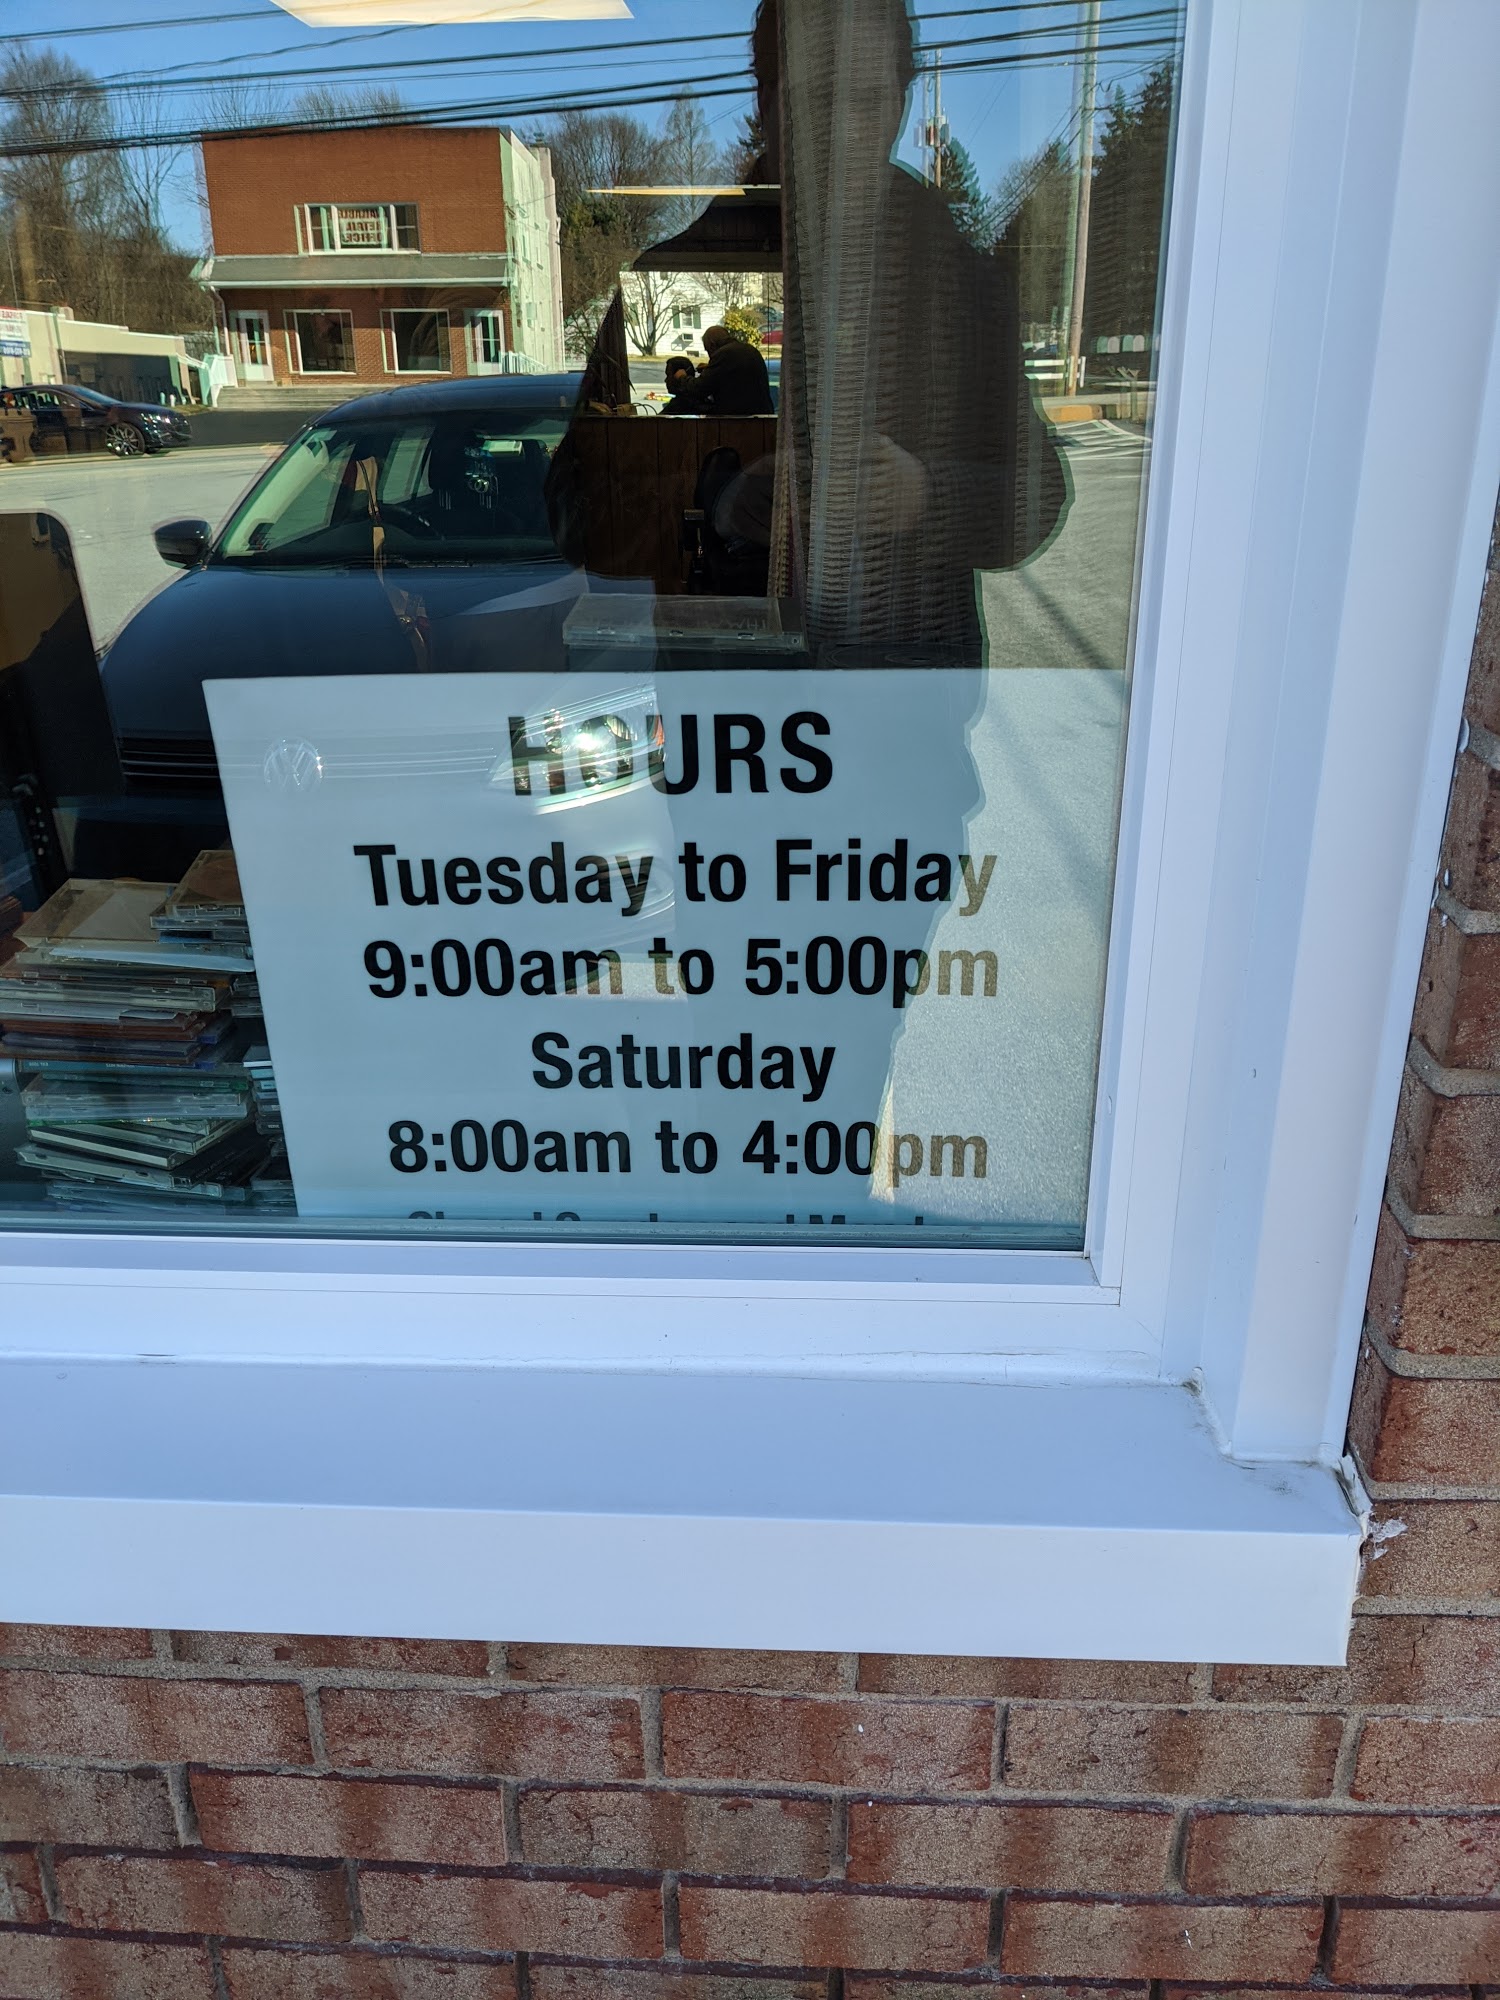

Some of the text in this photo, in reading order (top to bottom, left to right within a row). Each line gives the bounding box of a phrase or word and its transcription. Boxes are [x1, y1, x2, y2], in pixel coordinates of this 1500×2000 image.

[508, 712, 832, 796] HOURS
[353, 838, 998, 917] Tuesday to Friday
[364, 936, 998, 1009] 9:00am to 5:00pm
[532, 1031, 836, 1102] Saturday
[388, 1119, 988, 1188] 8:00am to 4:00pm
